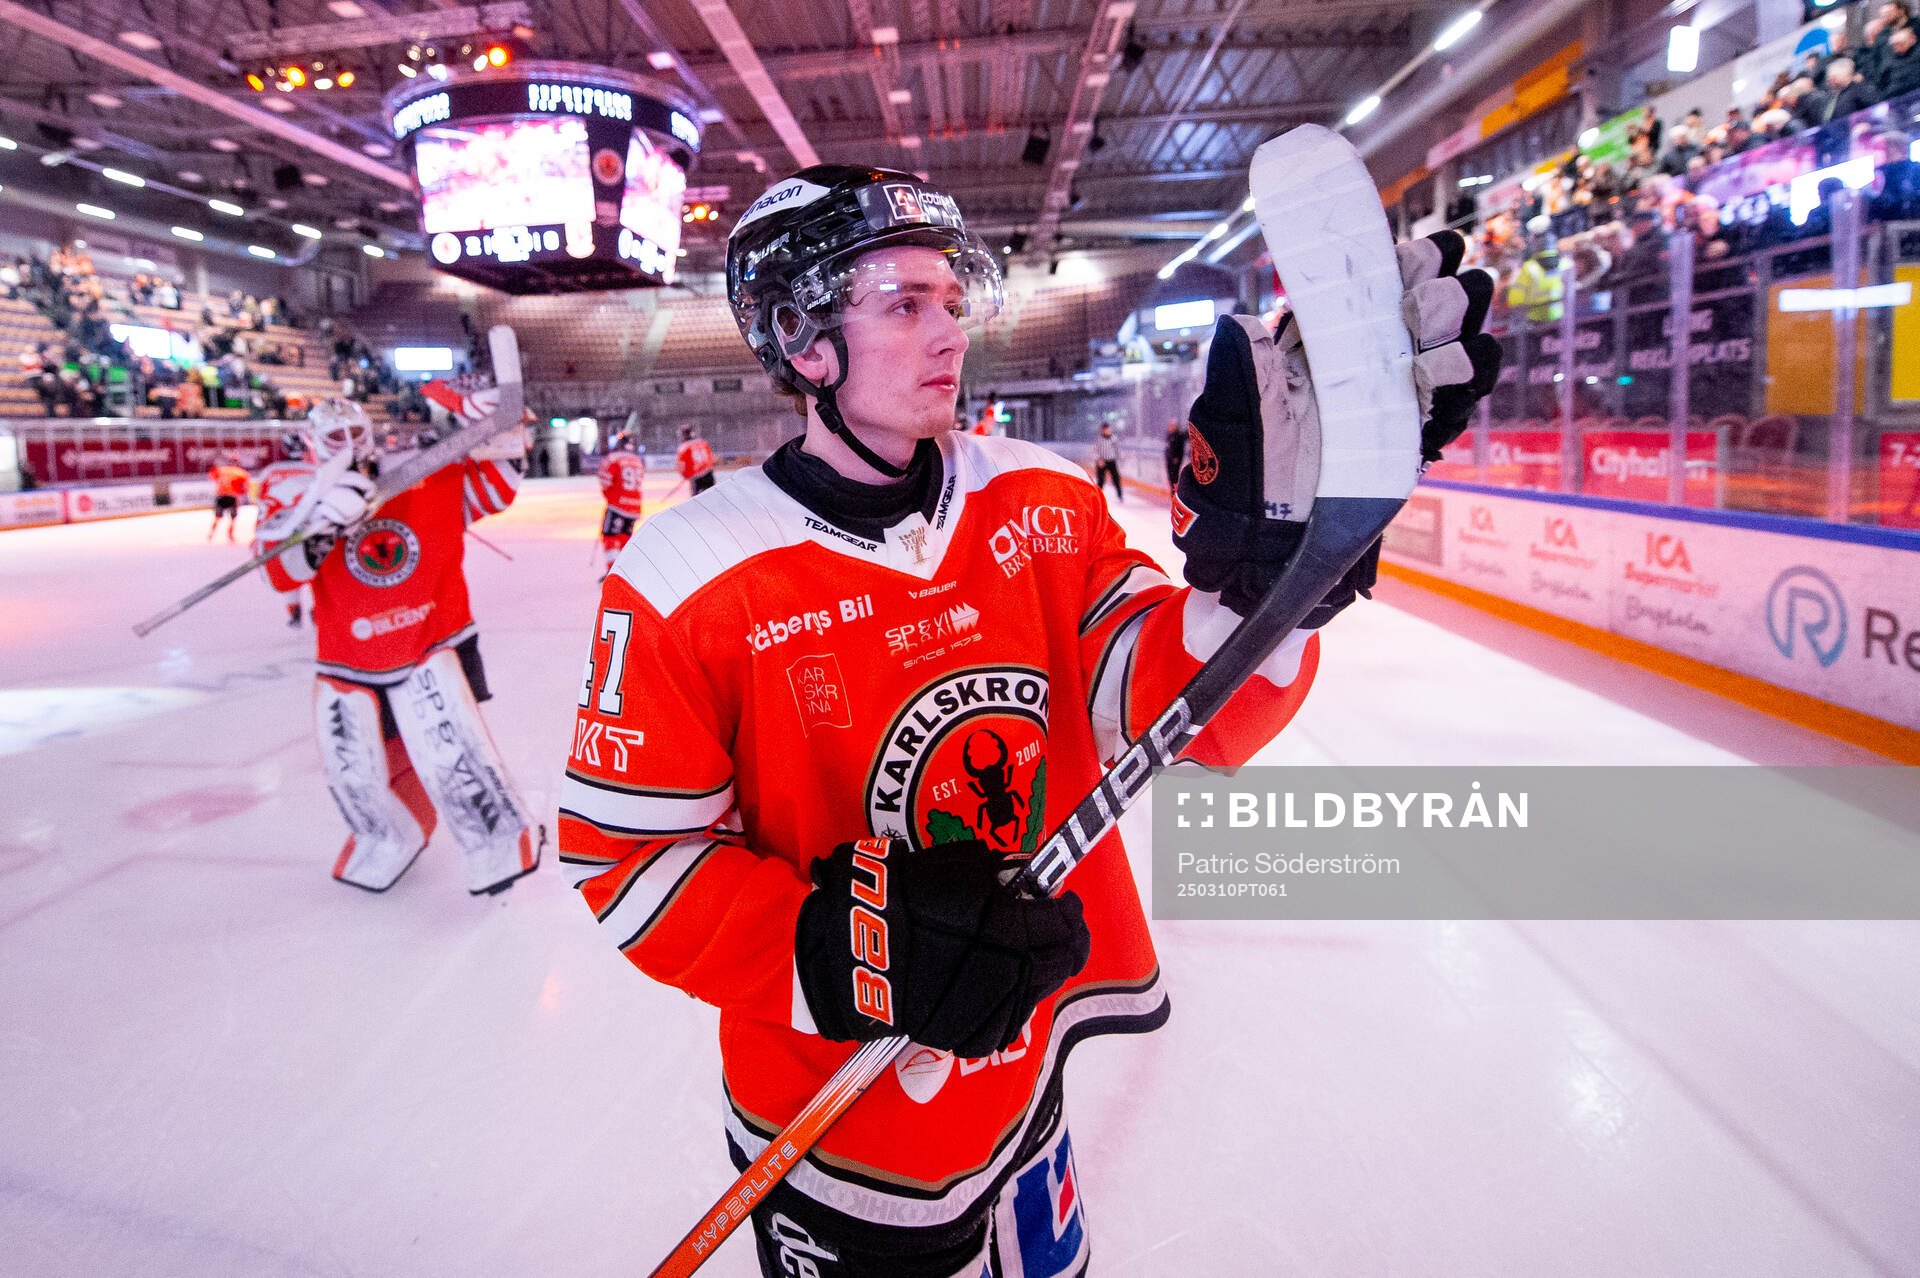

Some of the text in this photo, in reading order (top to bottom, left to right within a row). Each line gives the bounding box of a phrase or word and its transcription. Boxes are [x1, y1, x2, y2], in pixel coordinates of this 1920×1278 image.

[741, 184, 803, 223] ynacon
[804, 516, 878, 552] TEAMGEAR
[1544, 516, 1579, 550] ICA
[1644, 531, 1693, 573] ICA
[919, 580, 957, 598] BAUER
[838, 594, 874, 623] Bil
[903, 632, 983, 669] SINCE 1973
[569, 717, 645, 773] KT
[932, 740, 1041, 801] EST. 2001
[1030, 697, 1205, 893] AUER
